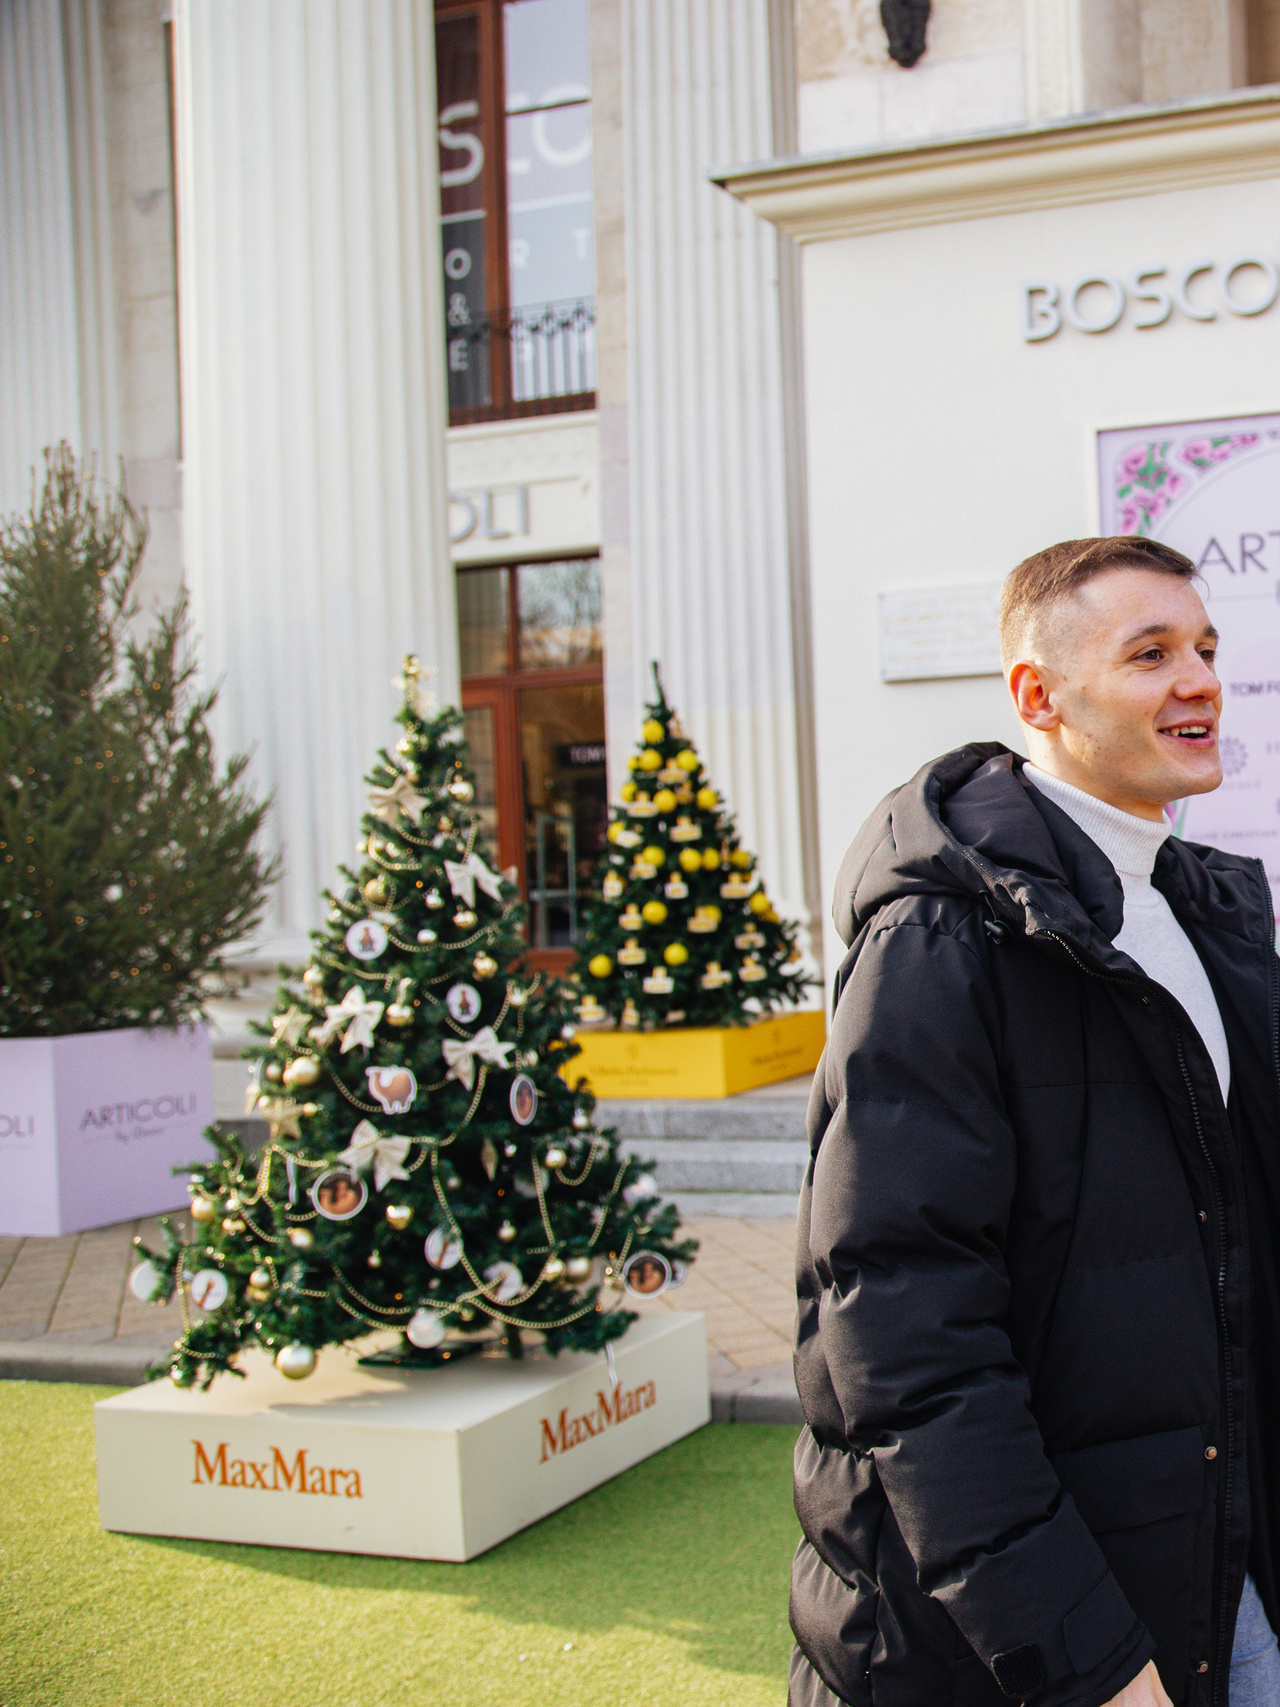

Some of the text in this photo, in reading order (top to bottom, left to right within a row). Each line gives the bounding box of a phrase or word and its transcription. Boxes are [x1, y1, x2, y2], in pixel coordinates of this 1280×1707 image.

[1229, 681, 1263, 698] TOM
[79, 1091, 198, 1133] ARTICOLI
[537, 1379, 657, 1465] MaxMara
[189, 1439, 364, 1499] MaxMara
